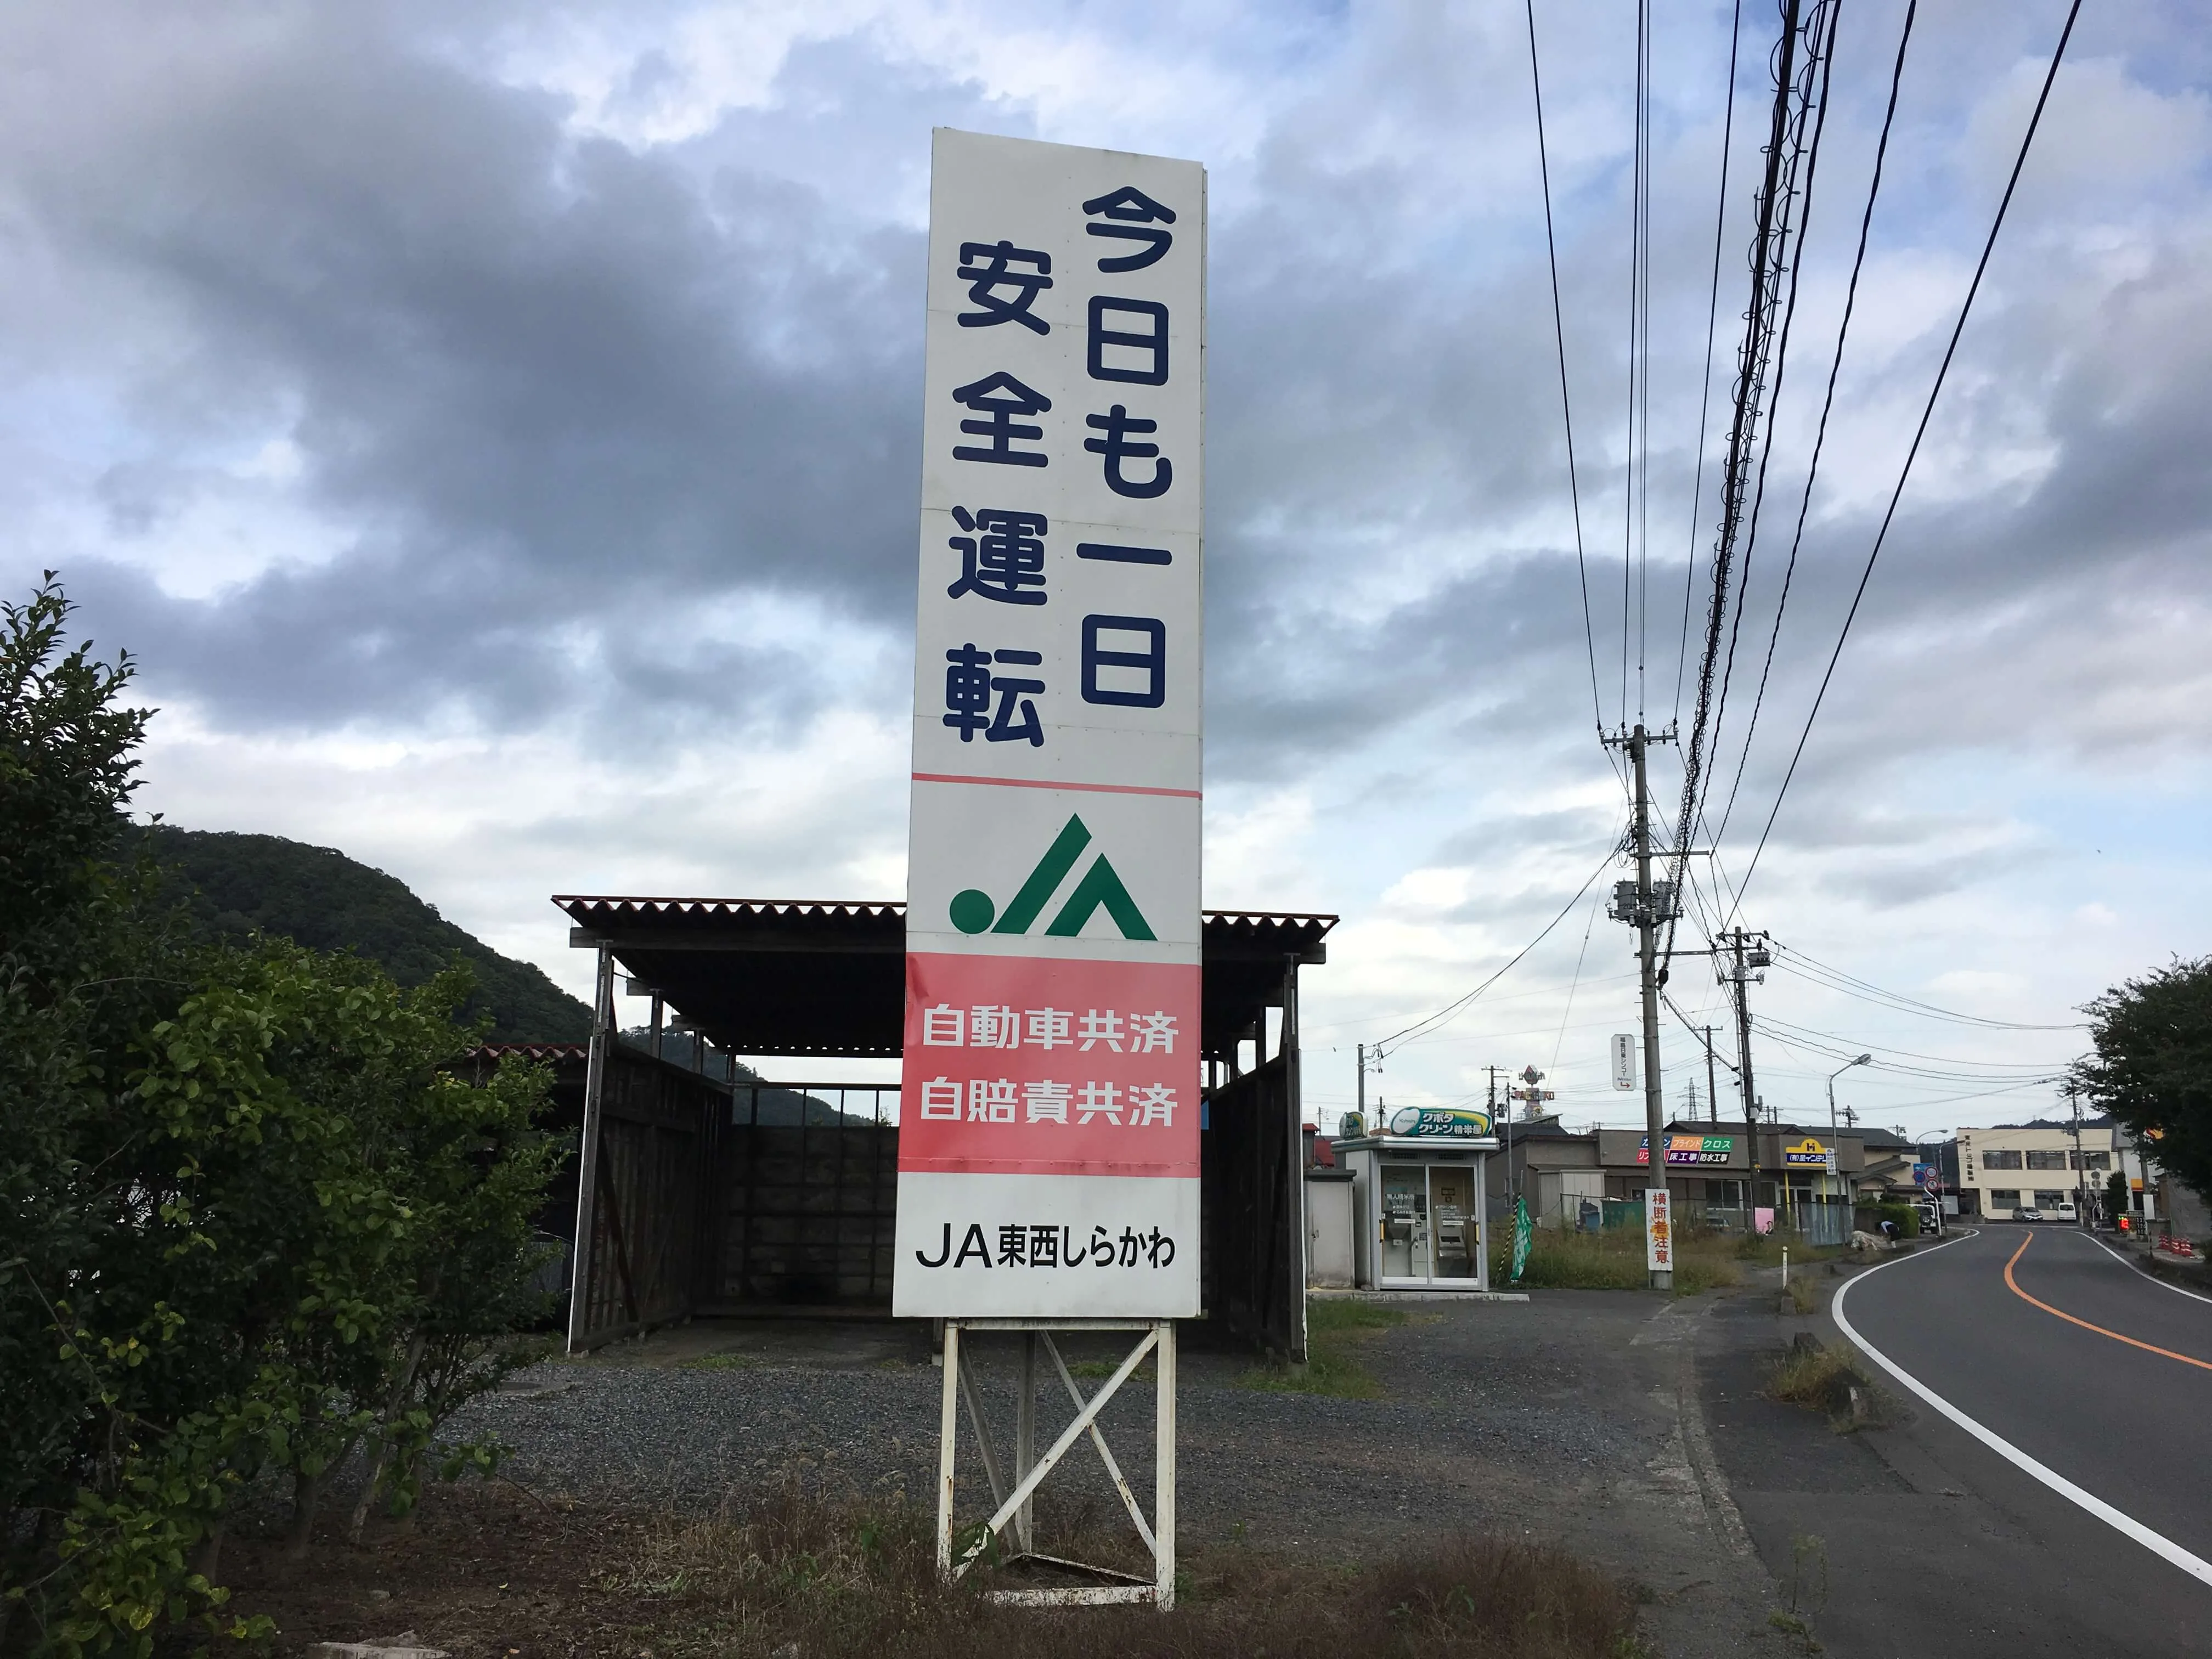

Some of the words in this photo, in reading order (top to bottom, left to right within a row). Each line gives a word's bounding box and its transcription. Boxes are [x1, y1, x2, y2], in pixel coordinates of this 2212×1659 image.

[1076, 186, 1176, 709] 今日も一日
[943, 240, 1053, 747] 安全運転
[922, 1003, 1180, 1054] 自動車共済
[921, 1076, 1178, 1127] 自賠責共済
[1423, 1111, 1454, 1123] クボタ
[1669, 1153, 1697, 1161] 床工事
[1673, 1139, 1700, 1148] ブラインド
[1700, 1153, 1728, 1162] 防水工事
[1703, 1139, 1730, 1148] クロス
[916, 1223, 1176, 1269] JA東西しらかわ
[1652, 1193, 1669, 1263] 横断者注意
